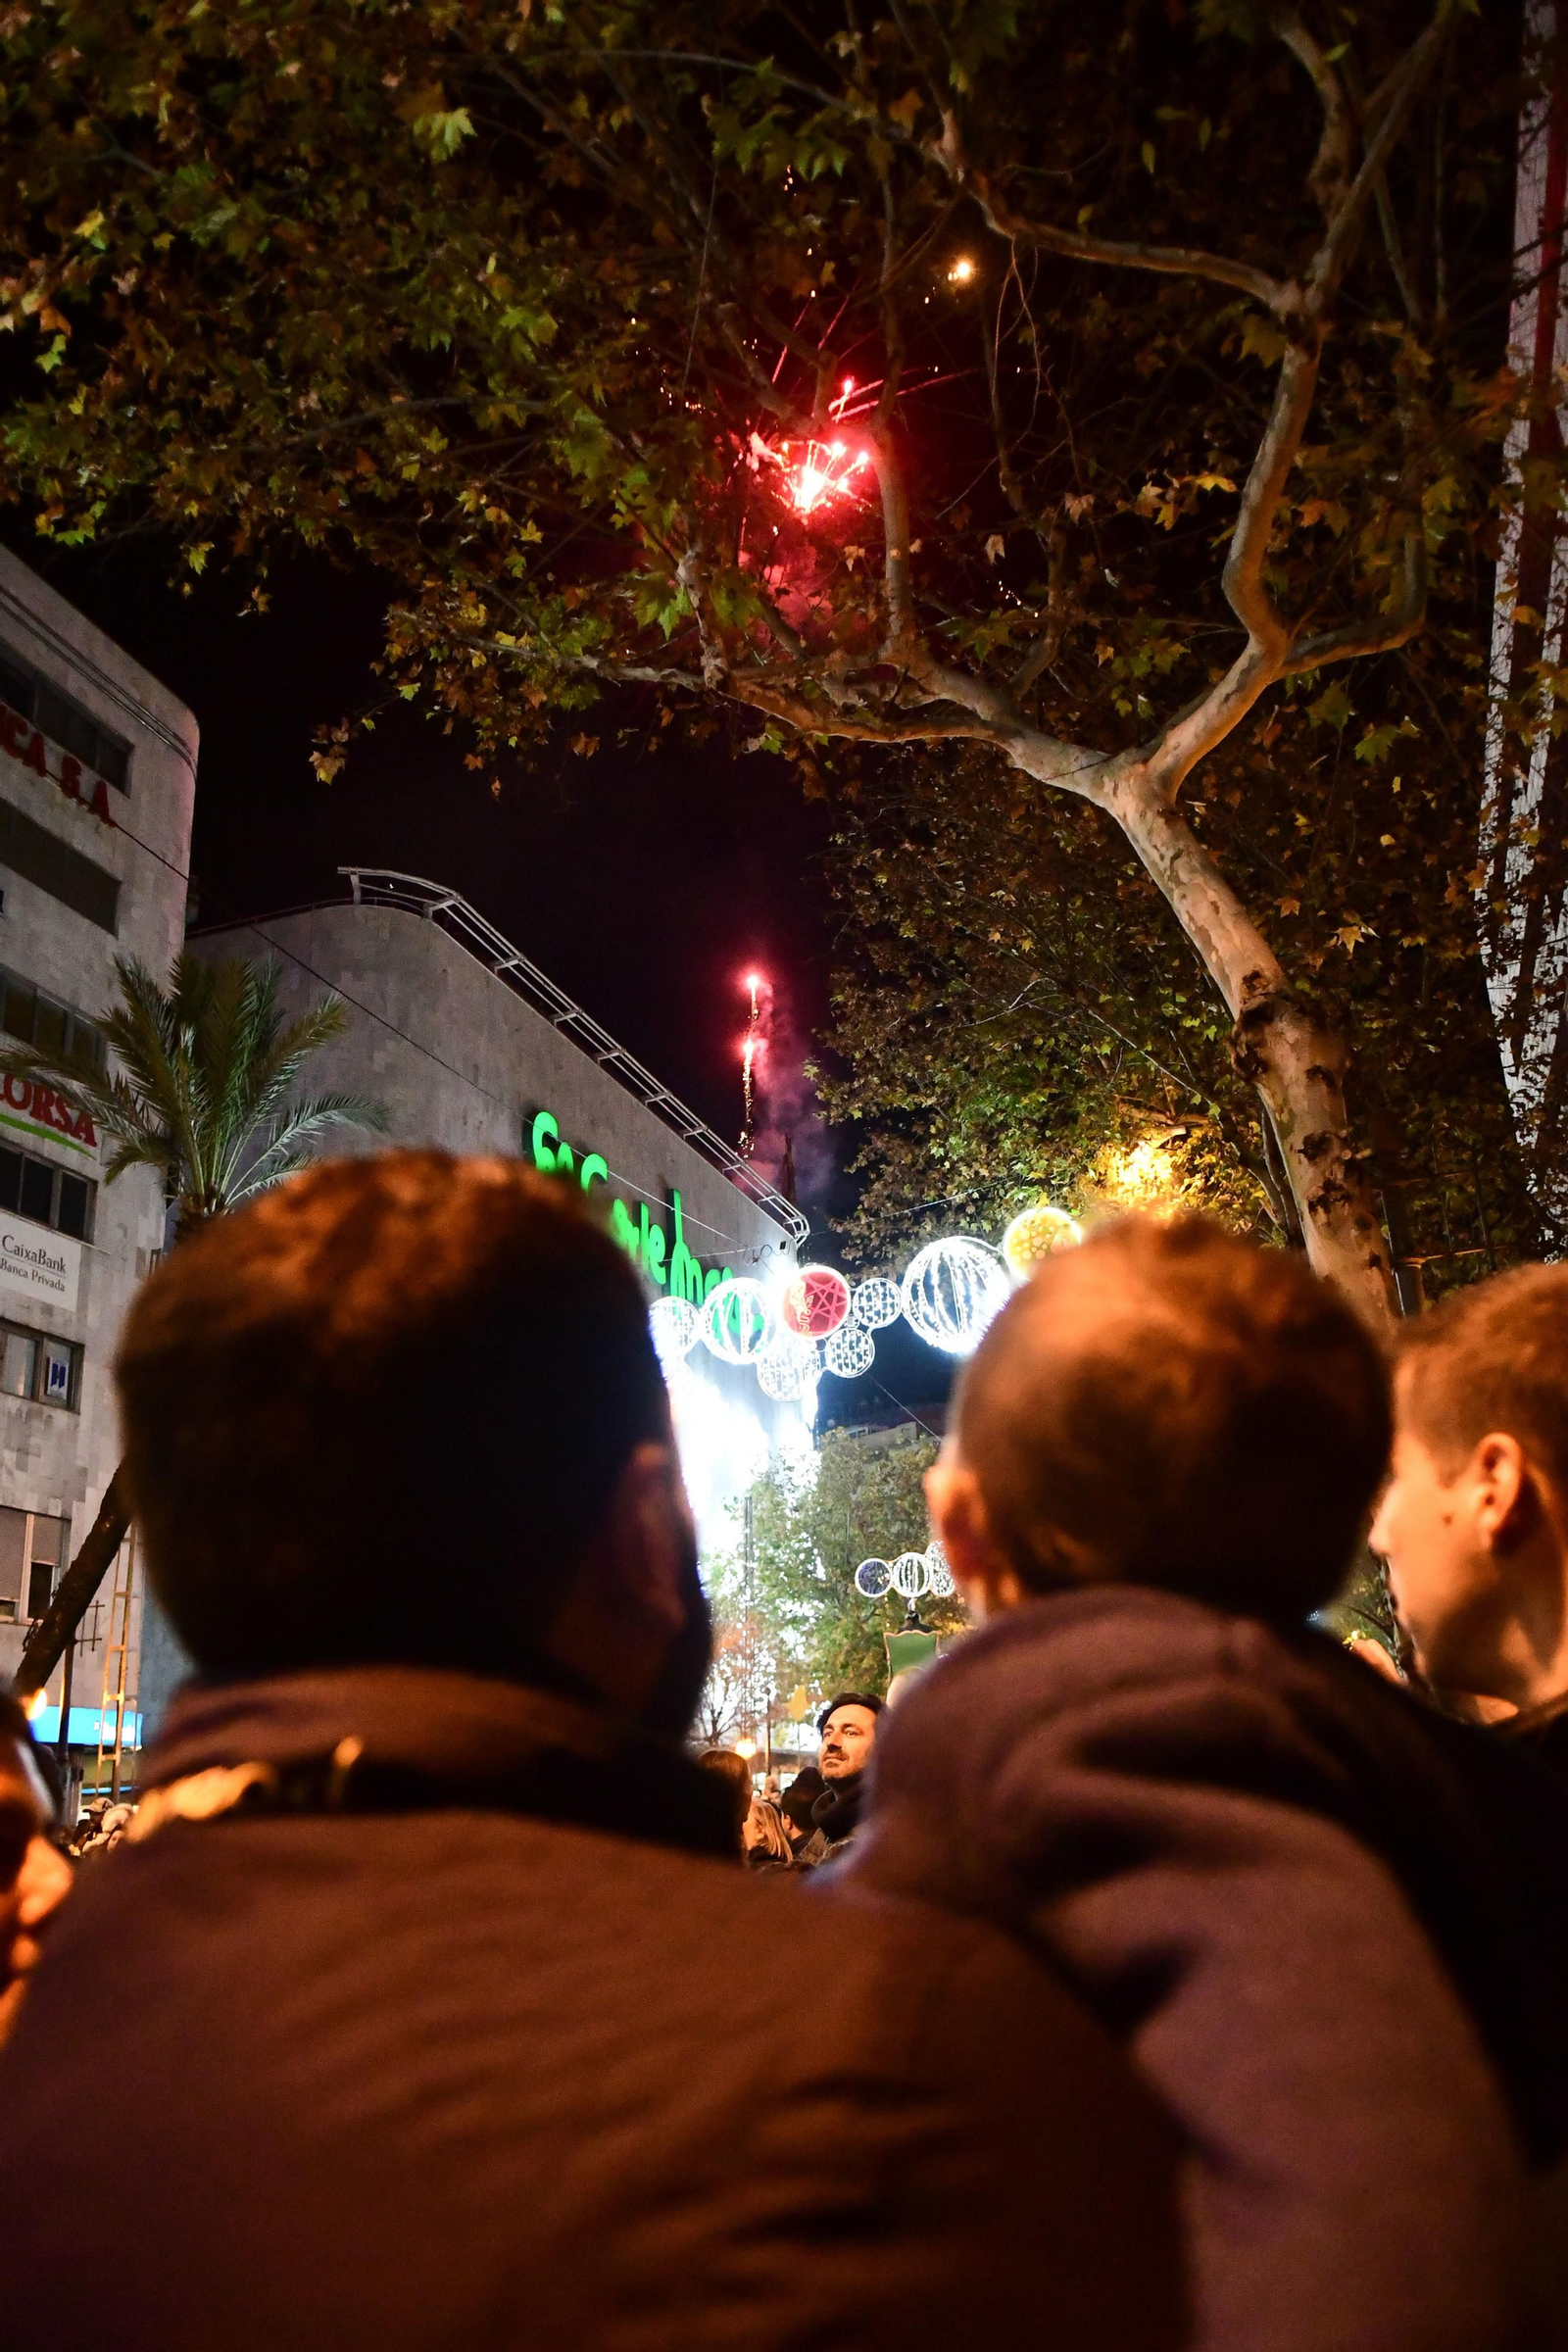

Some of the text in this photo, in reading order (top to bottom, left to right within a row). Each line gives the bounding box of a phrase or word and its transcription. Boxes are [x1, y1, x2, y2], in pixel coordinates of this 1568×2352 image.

[0, 1071, 98, 1148] ORSA
[2, 1234, 67, 1274] CaixaBank
[0, 1257, 66, 1293] Banca Privada
